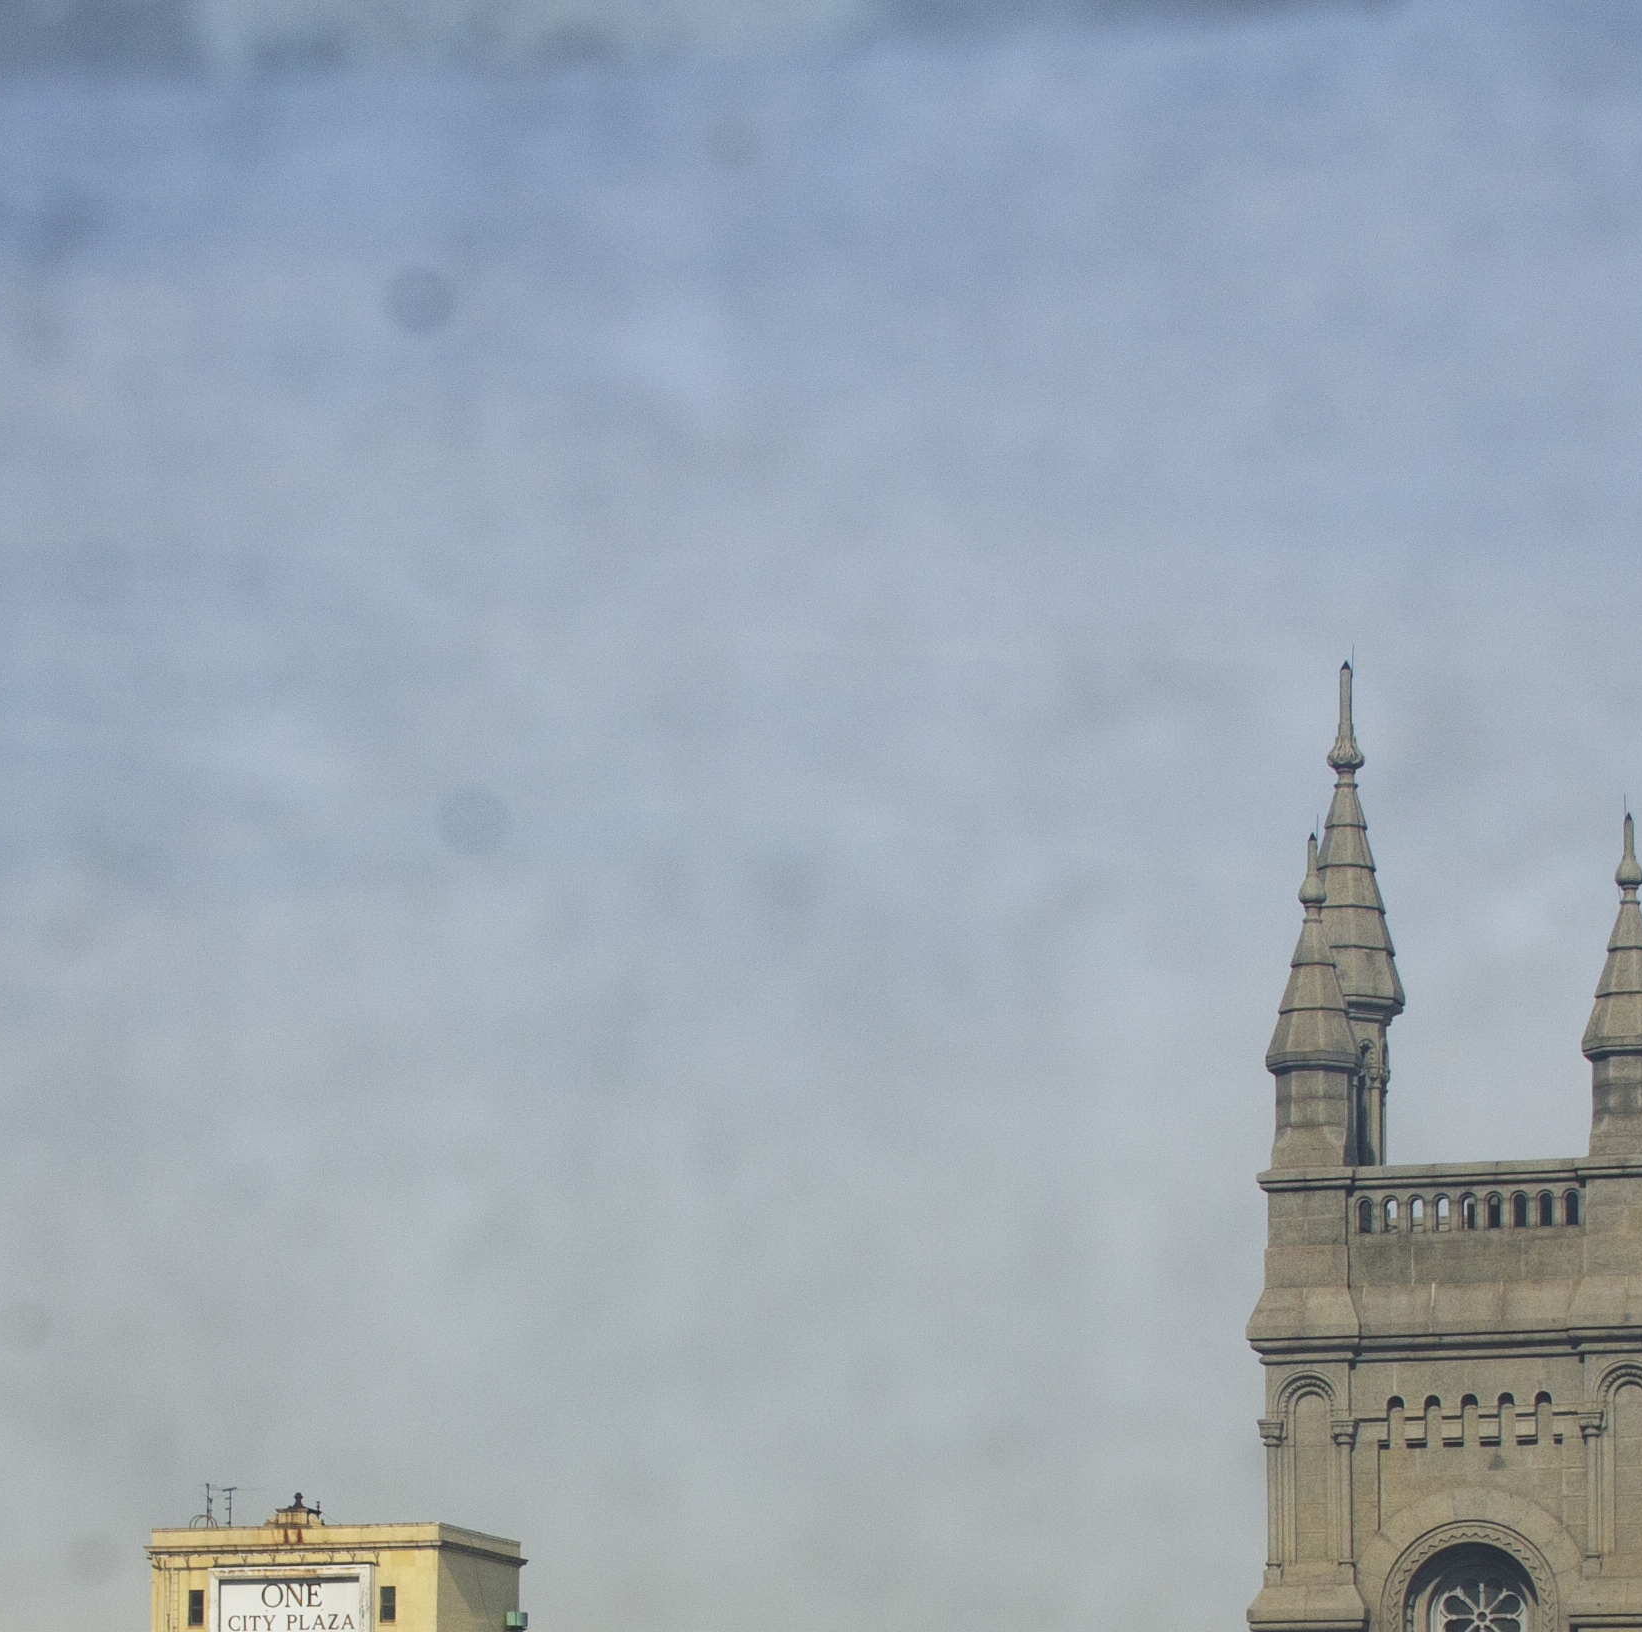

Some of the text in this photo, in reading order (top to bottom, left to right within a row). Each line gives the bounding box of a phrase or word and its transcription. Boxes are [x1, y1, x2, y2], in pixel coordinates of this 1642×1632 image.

[261, 1583, 323, 1608] ONE
[228, 1613, 355, 1632] CITY PLAZA
